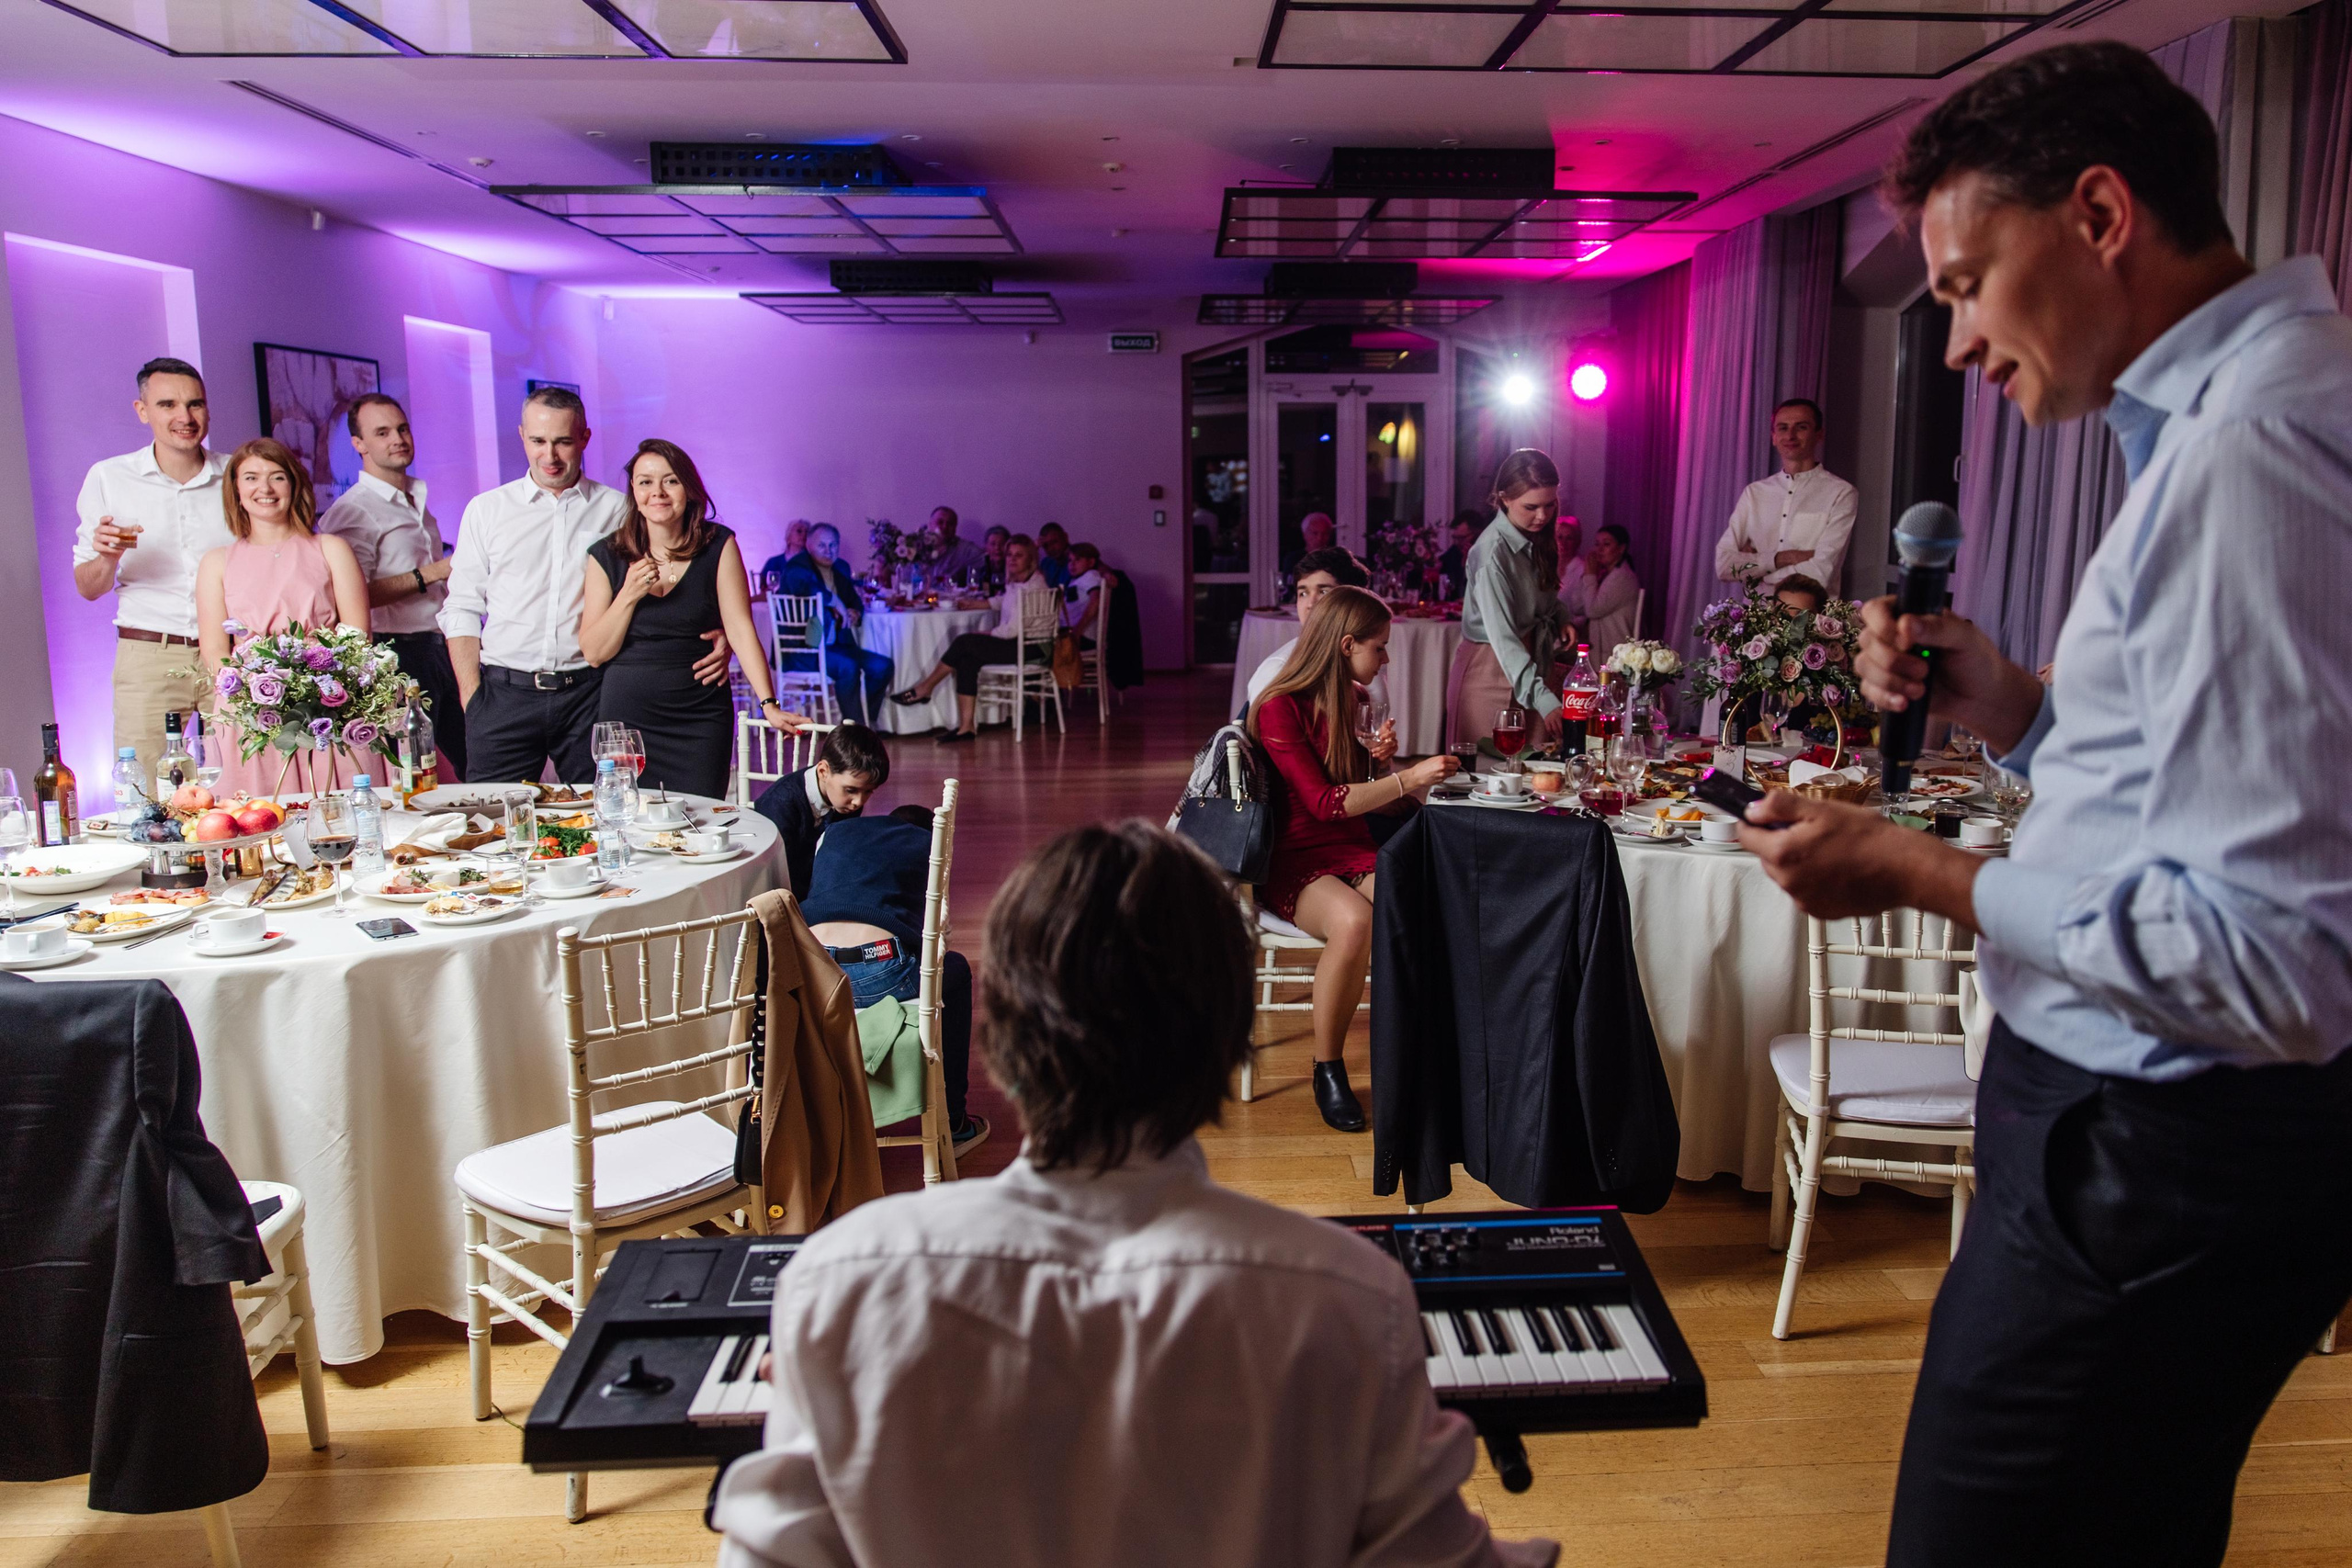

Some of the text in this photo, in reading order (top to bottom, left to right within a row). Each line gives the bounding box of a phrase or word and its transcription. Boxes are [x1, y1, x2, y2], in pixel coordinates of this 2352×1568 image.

[1114, 338, 1151, 348] ВЫХОД
[1565, 694, 1596, 709] Coca-C
[864, 943, 888, 954] TOMMY
[865, 949, 891, 960] HILFIGER
[1549, 1225, 1600, 1235] Roland
